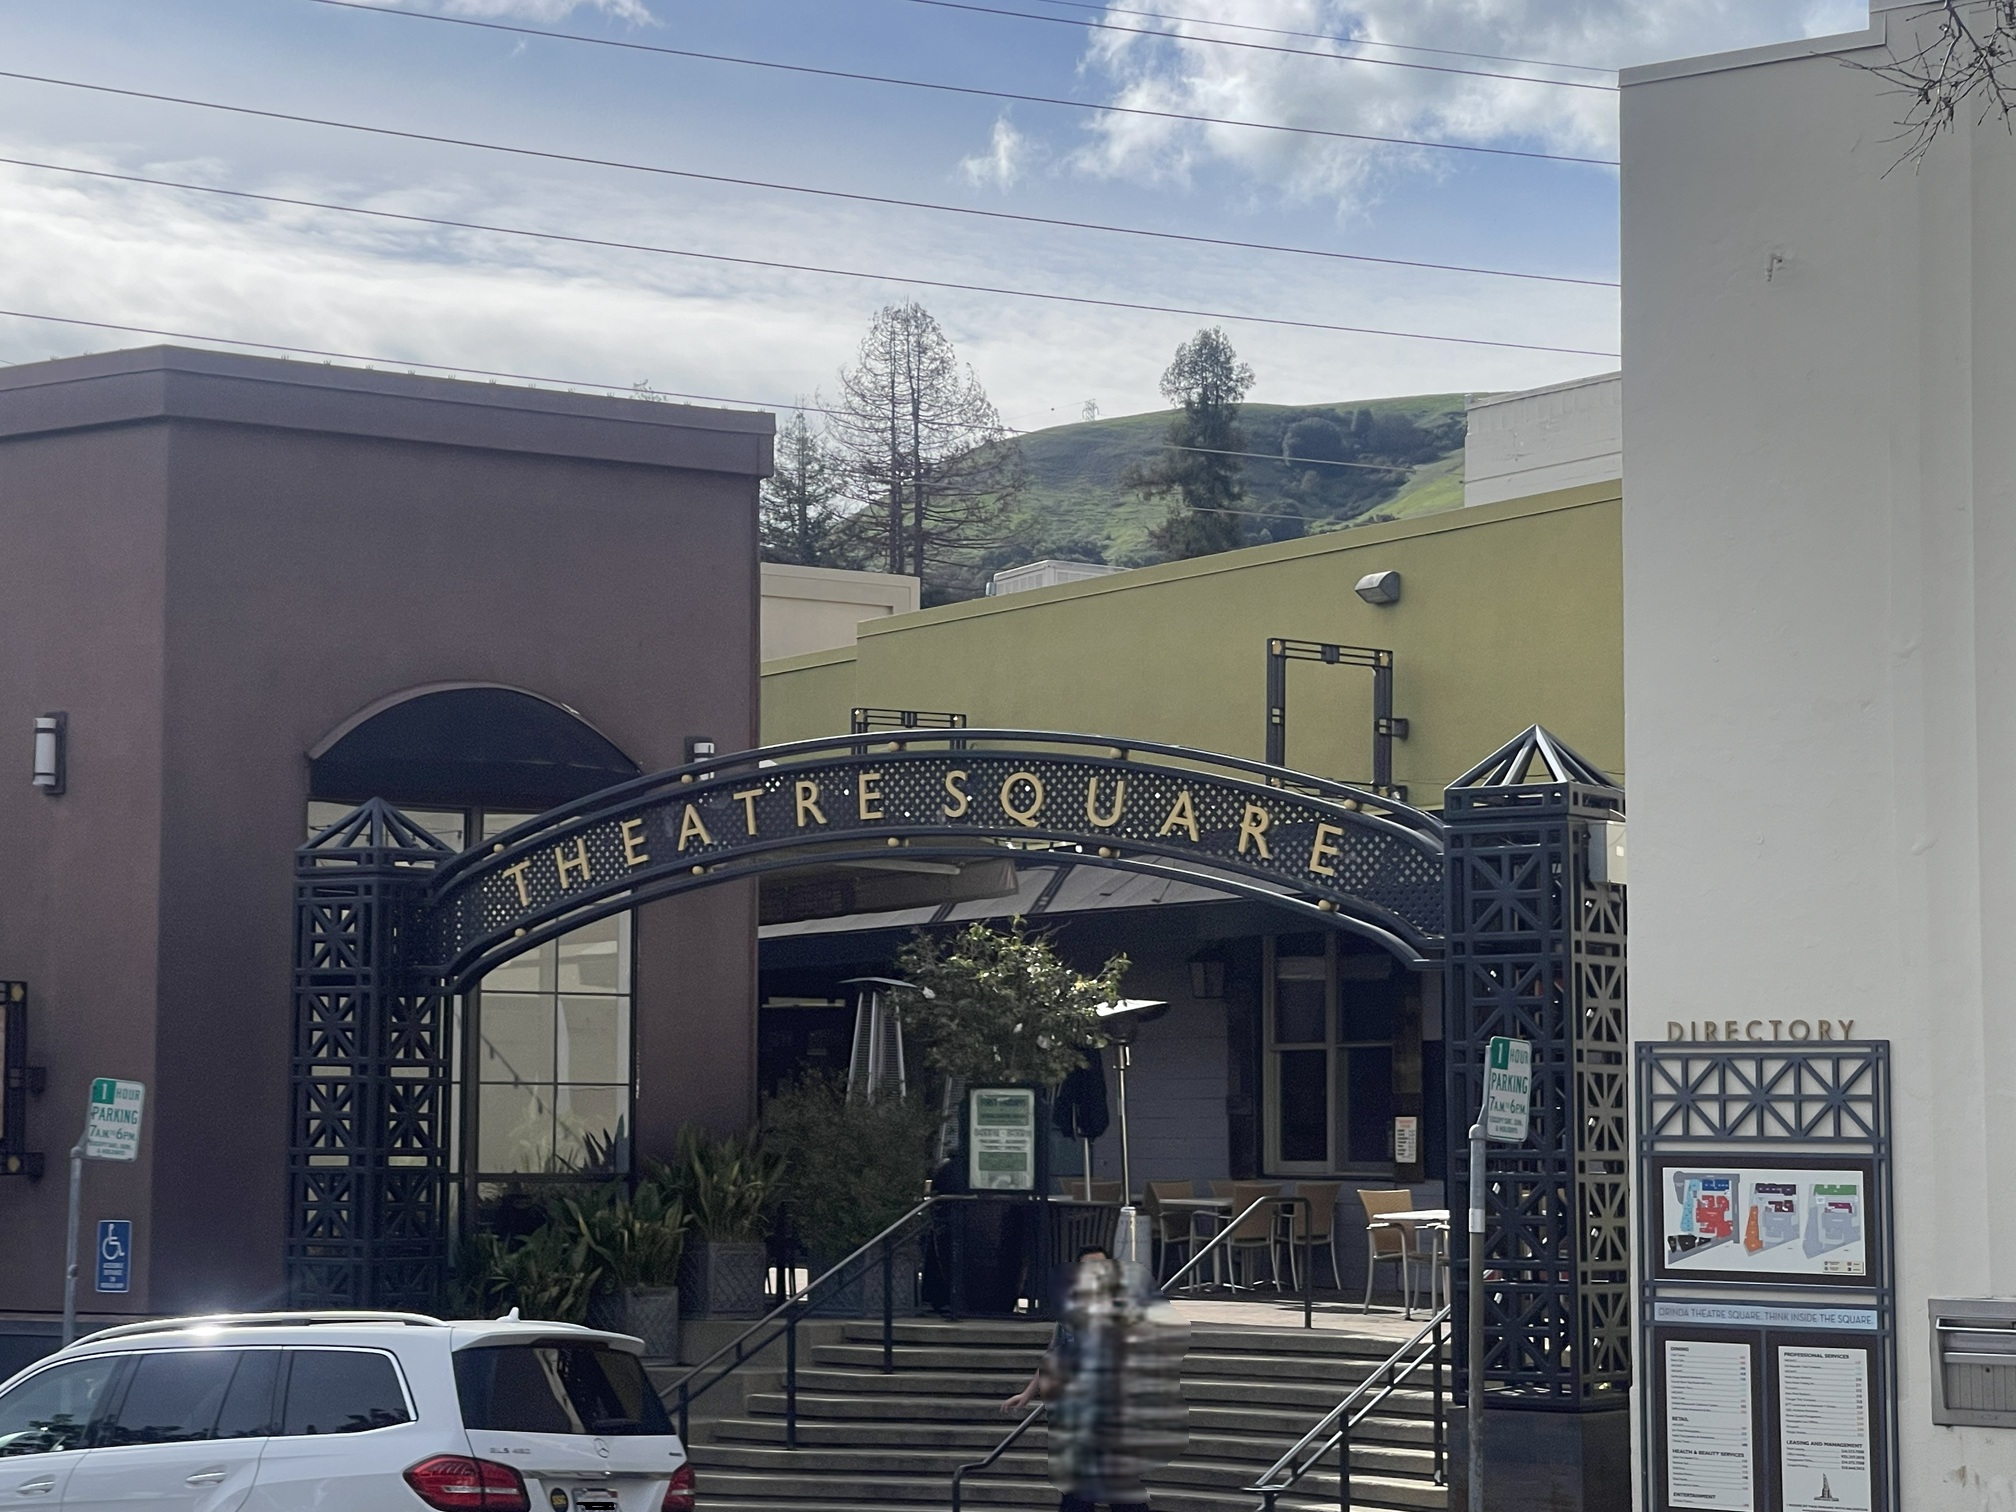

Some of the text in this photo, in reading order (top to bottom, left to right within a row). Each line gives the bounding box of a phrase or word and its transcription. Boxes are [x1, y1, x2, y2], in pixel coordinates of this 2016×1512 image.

[502, 770, 1345, 907] THEATRE SQUARE
[1667, 1019, 1855, 1041] DIRECTORY
[1498, 1043, 1529, 1065] 1 HOUR
[101, 1083, 141, 1101] 1 HOUR
[1490, 1072, 1528, 1094] PARKING
[91, 1106, 138, 1124] PARKING
[1658, 1307, 1689, 1317] ORINDA
[1691, 1308, 1726, 1319] THEATRE
[1764, 1311, 1789, 1321] THINK
[1790, 1312, 1817, 1322] INSIDE
[1819, 1313, 1836, 1323] THE
